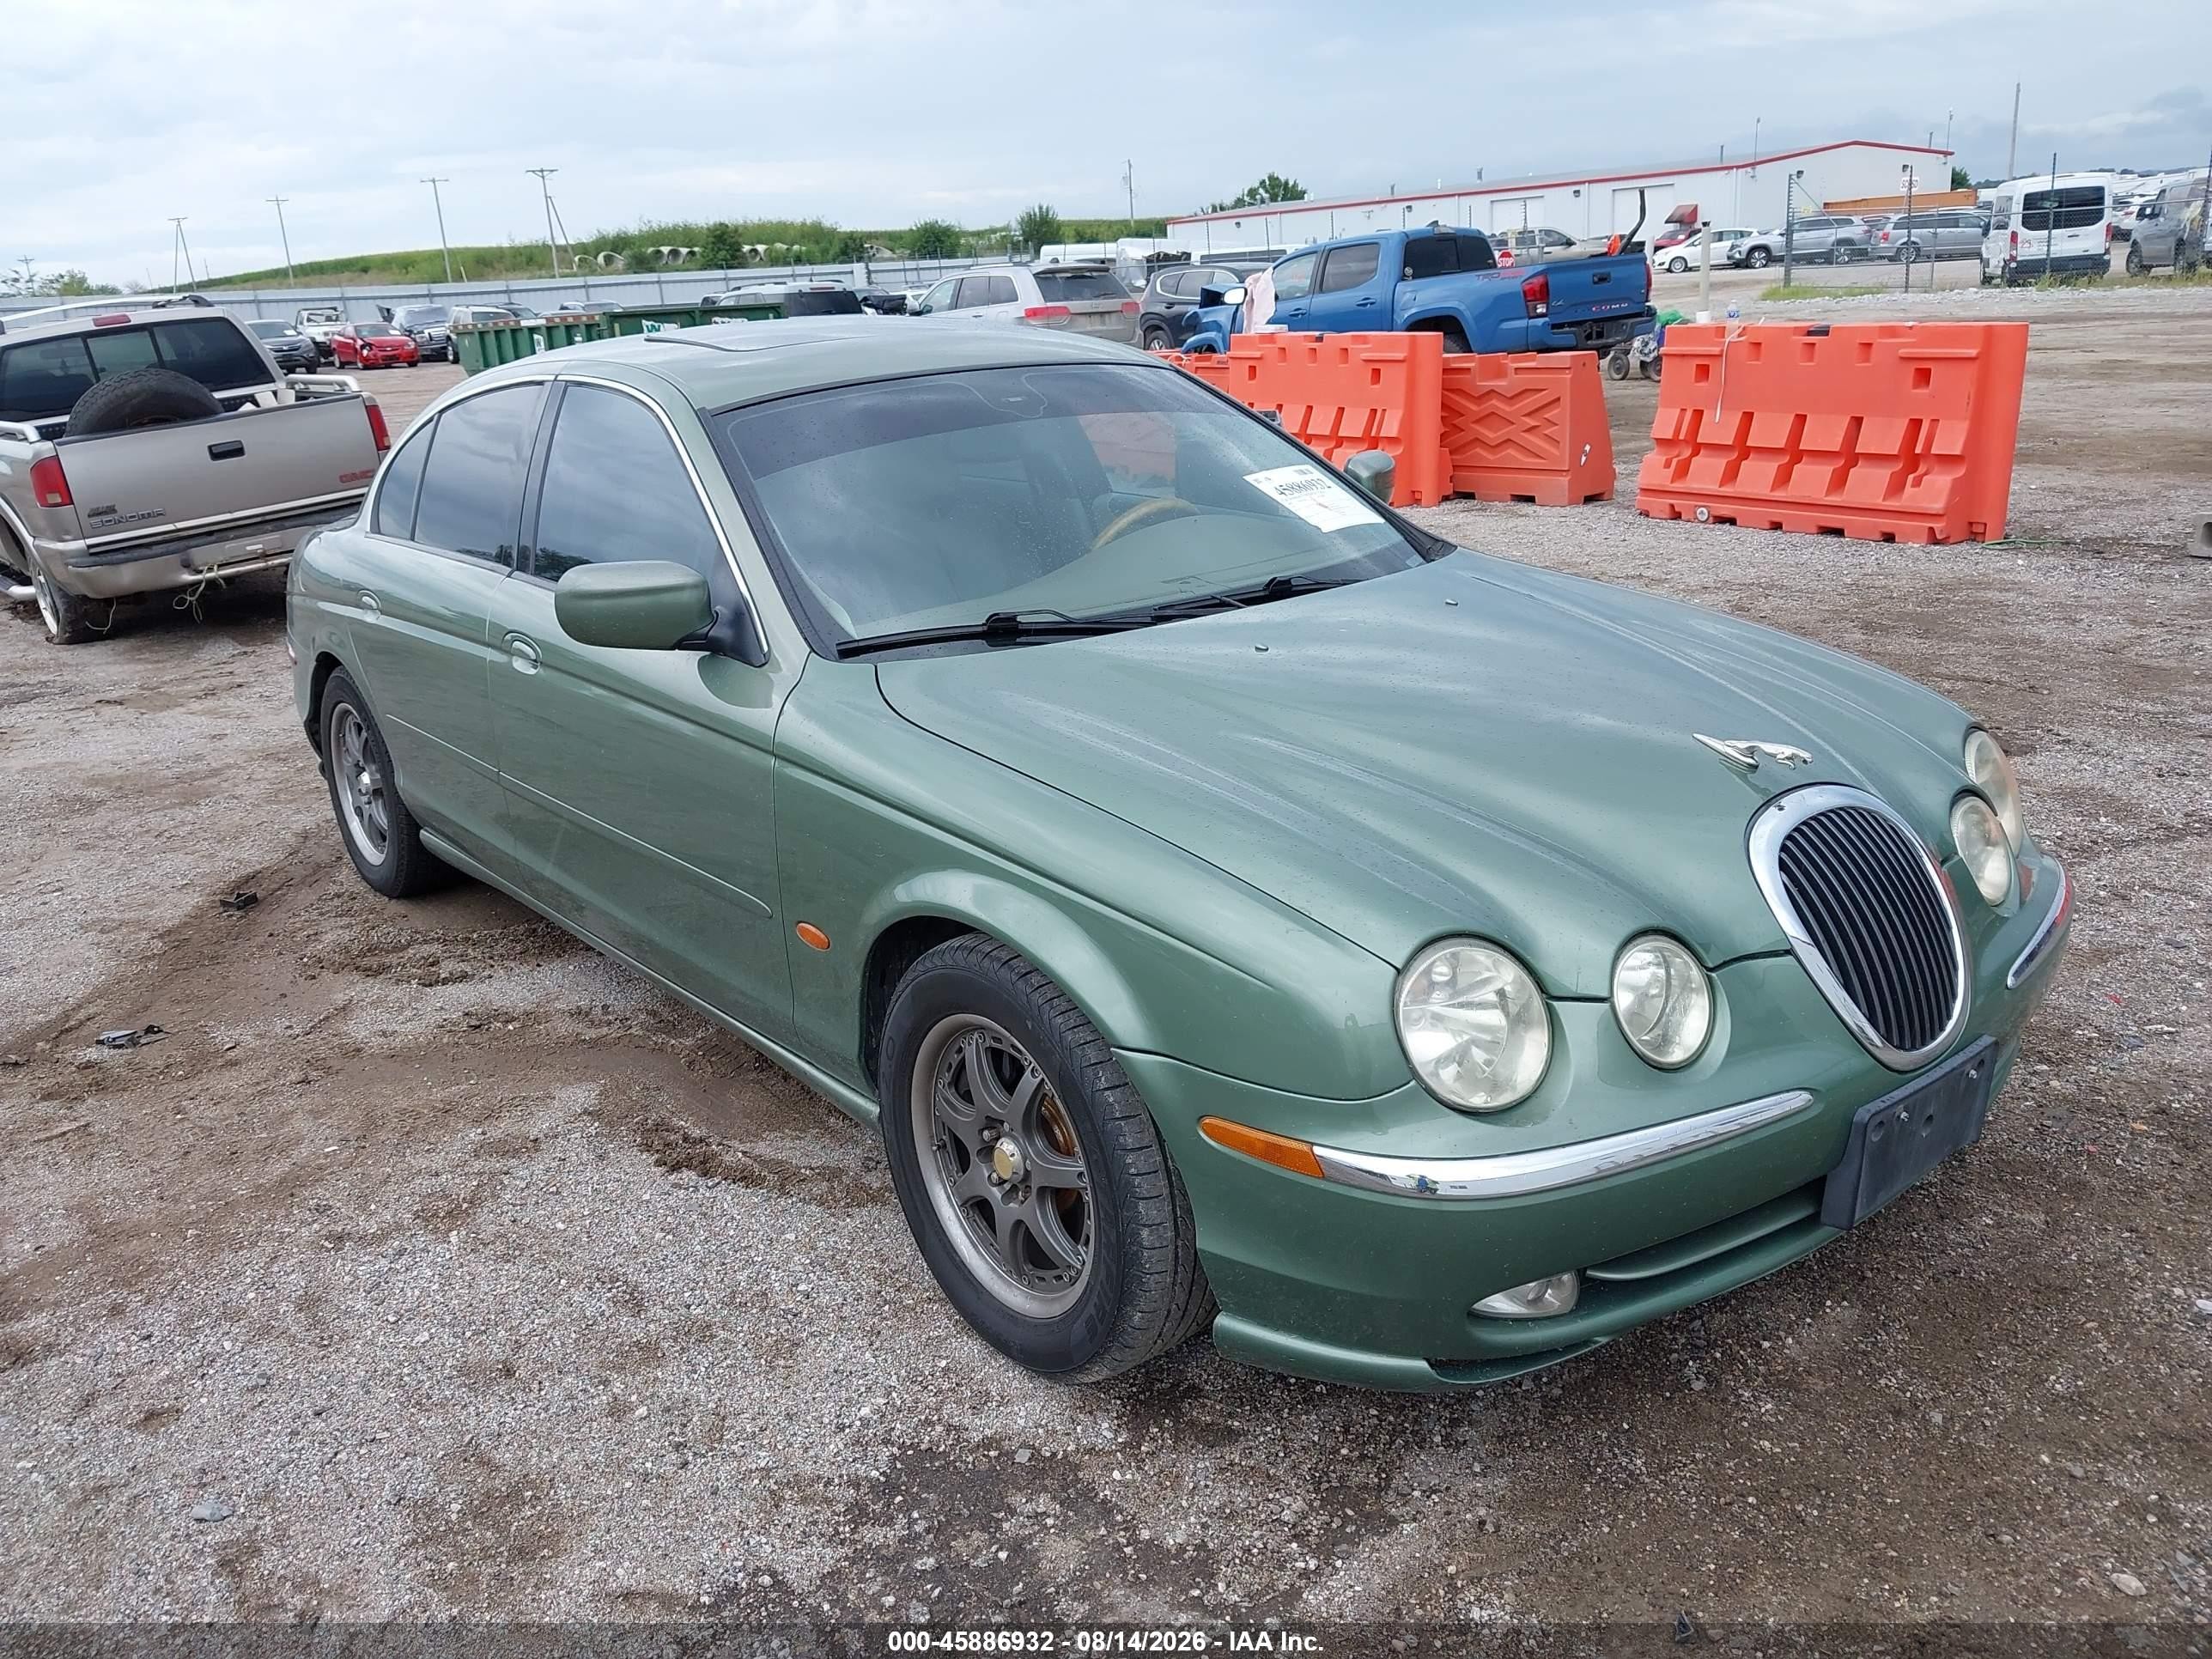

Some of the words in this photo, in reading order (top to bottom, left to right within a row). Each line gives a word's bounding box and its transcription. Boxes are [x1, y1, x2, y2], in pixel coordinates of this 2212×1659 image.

[1498, 258, 1516, 268] STOP
[1273, 478, 1332, 496] 45886932
[89, 507, 166, 529] SONOMA
